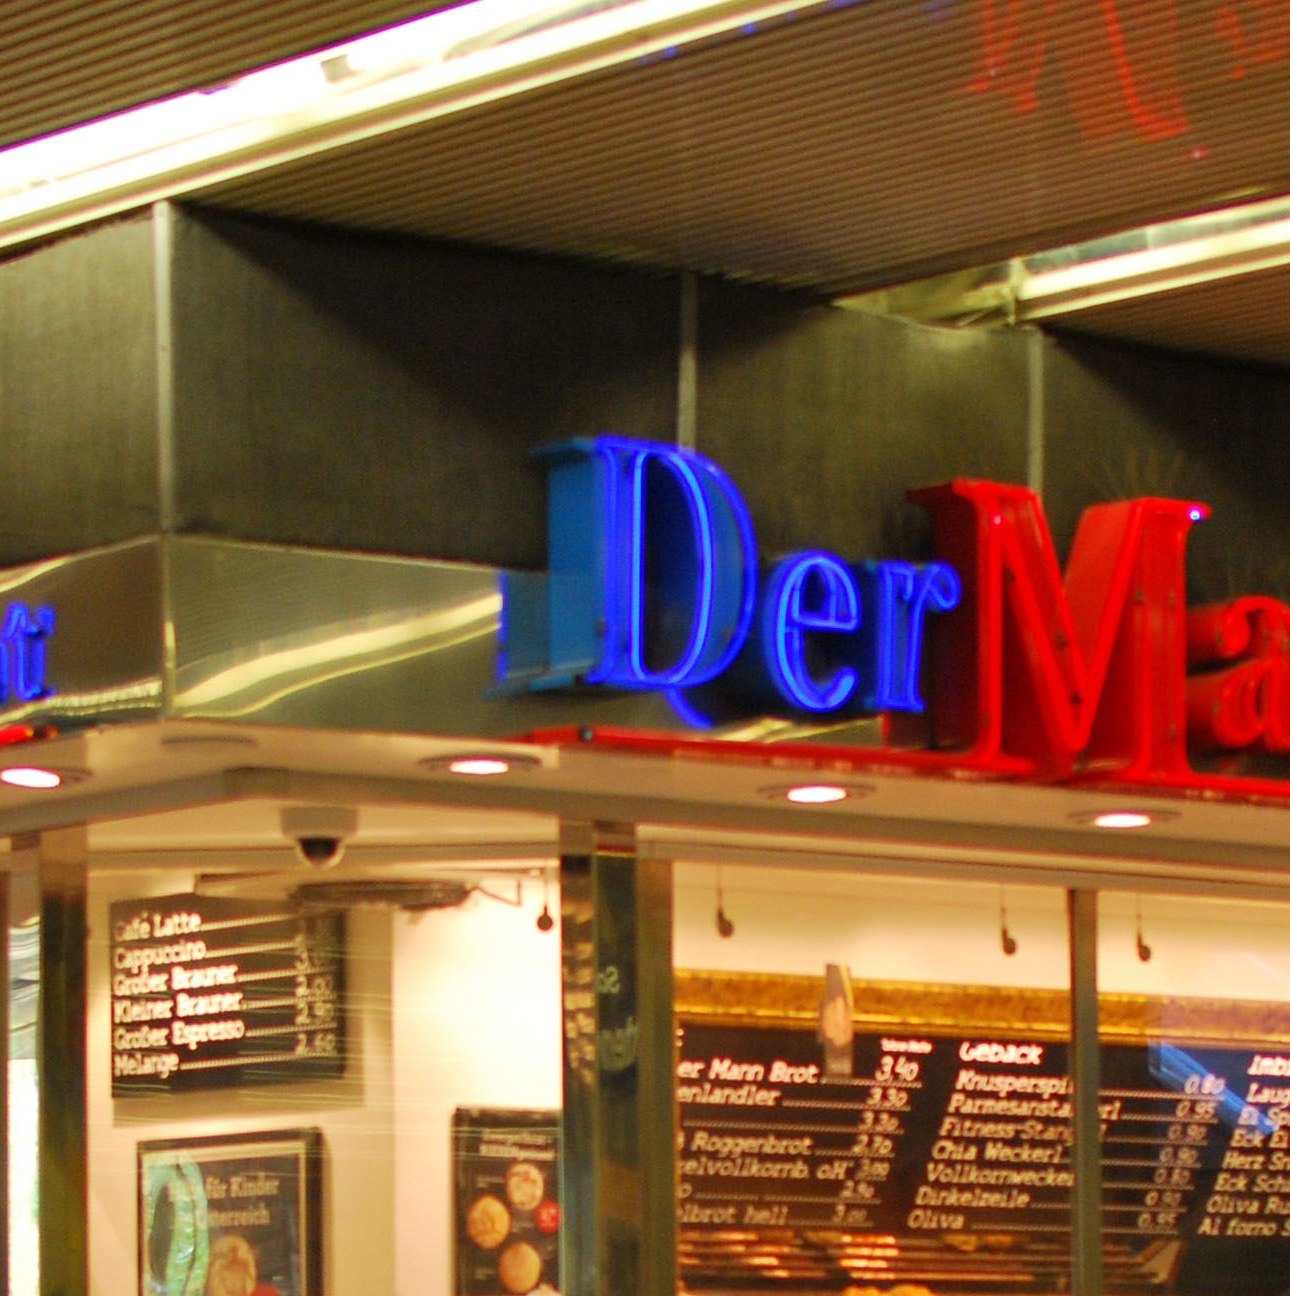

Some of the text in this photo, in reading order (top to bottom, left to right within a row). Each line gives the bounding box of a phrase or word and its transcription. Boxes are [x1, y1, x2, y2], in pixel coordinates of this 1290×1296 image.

[585, 434, 961, 712] Der
[153, 911, 202, 938] Latte
[171, 963, 239, 991] Brauner
[114, 998, 174, 1024] Kleiner
[176, 992, 244, 1018] Brauner
[172, 1019, 245, 1051] Espresso
[114, 1052, 180, 1080] Melange
[677, 1058, 706, 1080] er
[708, 1055, 765, 1082] Mann
[767, 1060, 820, 1085] Brot
[690, 1129, 814, 1159] Roggenbrot
[931, 1139, 978, 1162] Chia
[1222, 1151, 1266, 1170] Herz
[229, 1171, 280, 1198] Kinder
[1214, 1172, 1249, 1192] Eck
